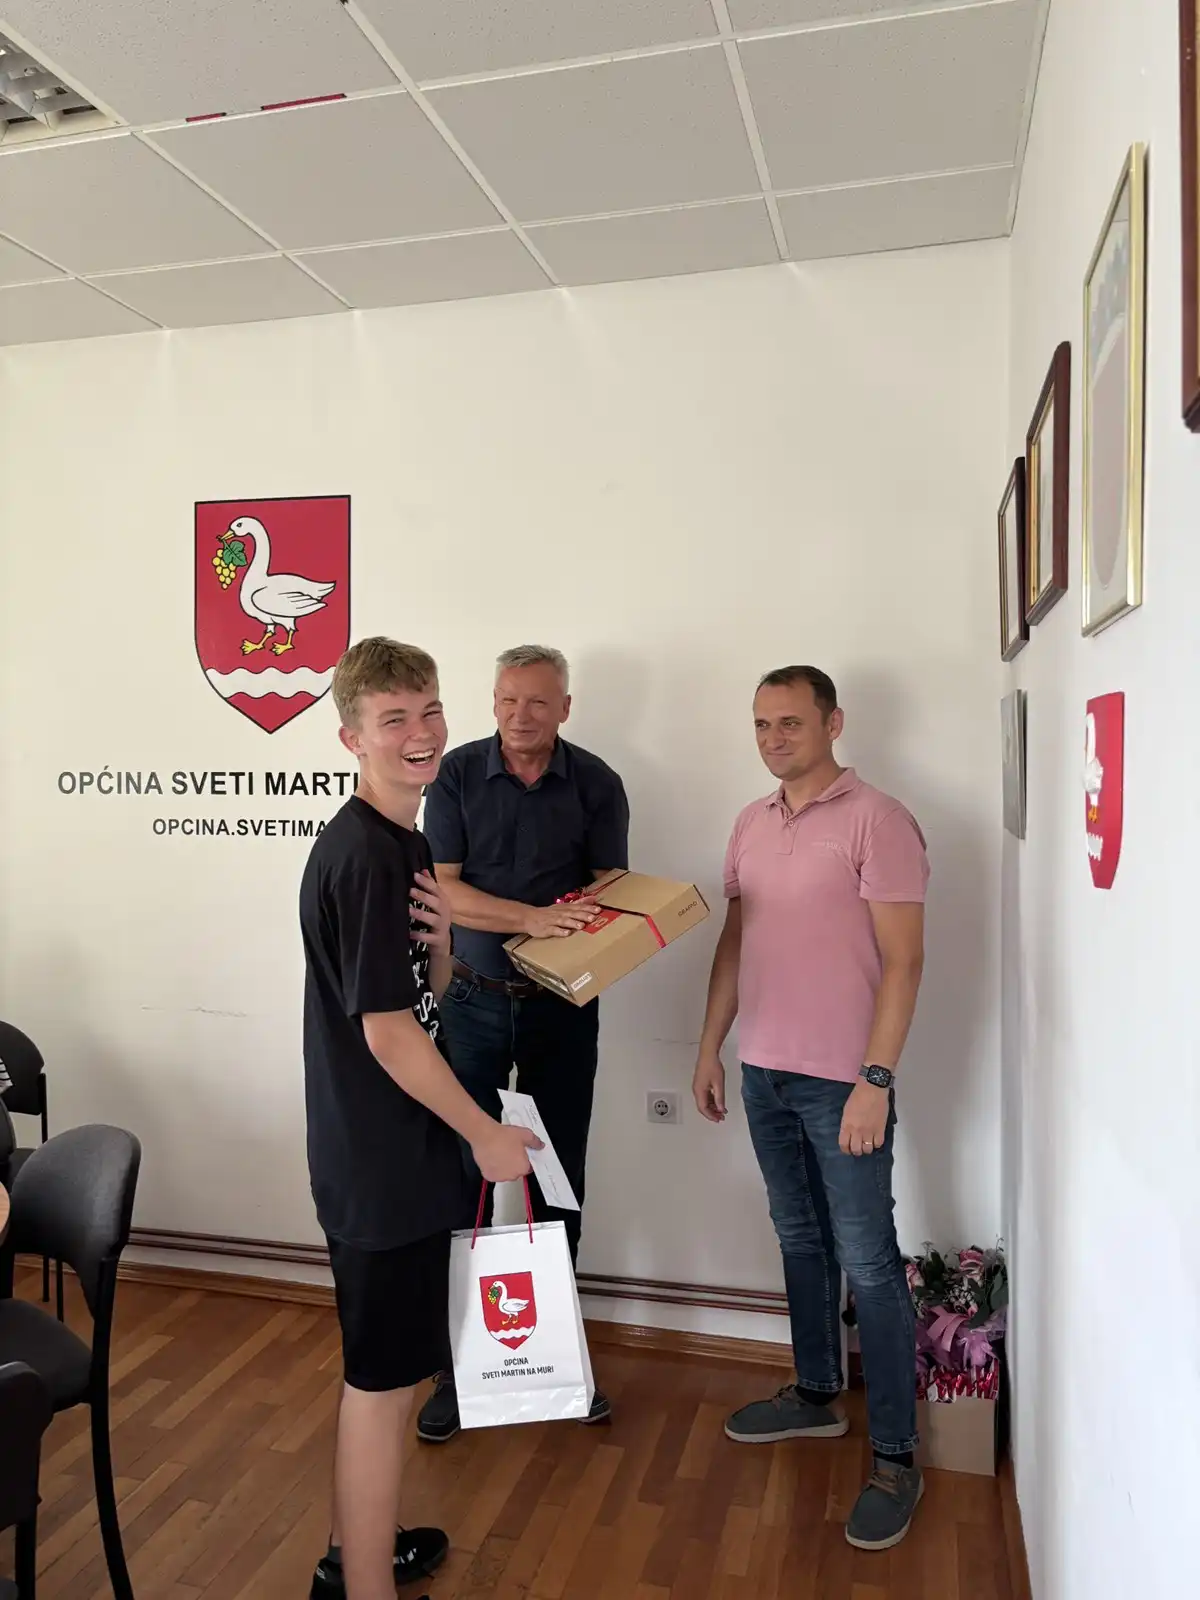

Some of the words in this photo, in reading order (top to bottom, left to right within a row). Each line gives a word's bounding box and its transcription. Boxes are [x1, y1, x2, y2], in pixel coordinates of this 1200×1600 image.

[58, 765, 163, 794] OPĆINA
[171, 771, 254, 795] SVETI
[265, 771, 359, 795] MARTI
[152, 818, 327, 836] OPCINA.SVETIMA
[482, 1371, 500, 1380] SVETI
[501, 1368, 526, 1378] MARTIN
[526, 1367, 536, 1376] NA
[537, 1365, 554, 1375] MURI
